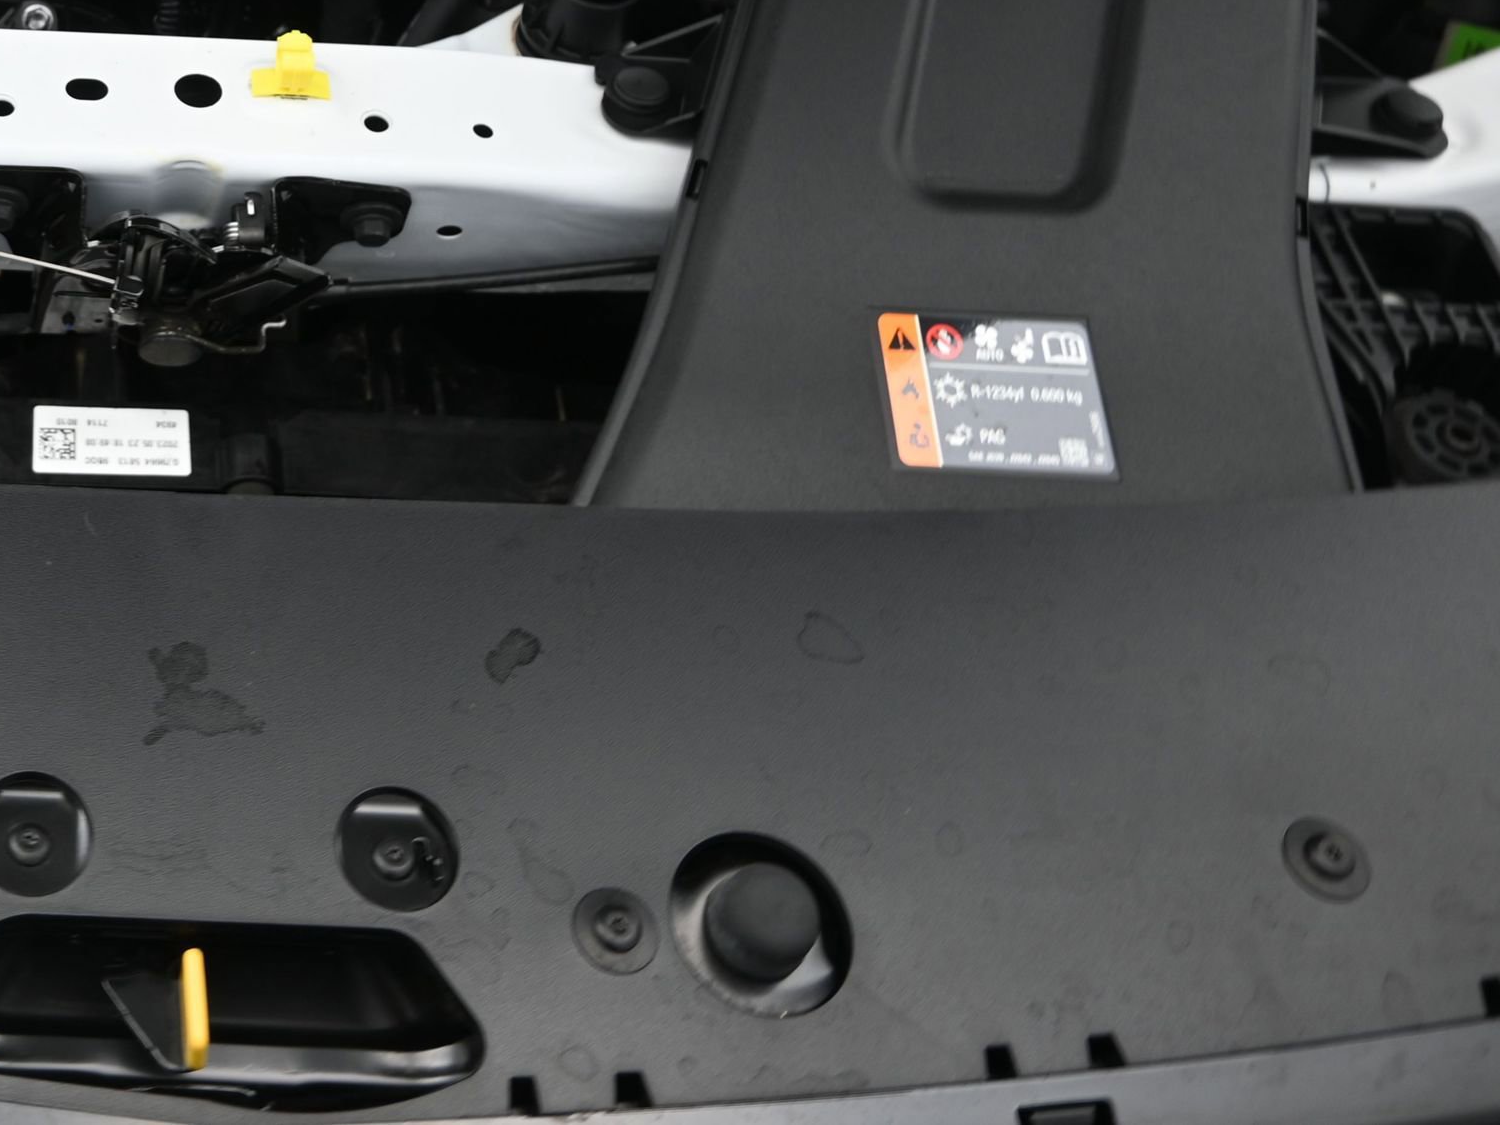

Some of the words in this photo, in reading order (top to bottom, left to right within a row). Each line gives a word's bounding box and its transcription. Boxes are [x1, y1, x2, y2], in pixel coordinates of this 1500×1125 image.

[975, 348, 1004, 362] AUTO
[1066, 388, 1083, 406] kg
[979, 427, 1006, 445] PAG
